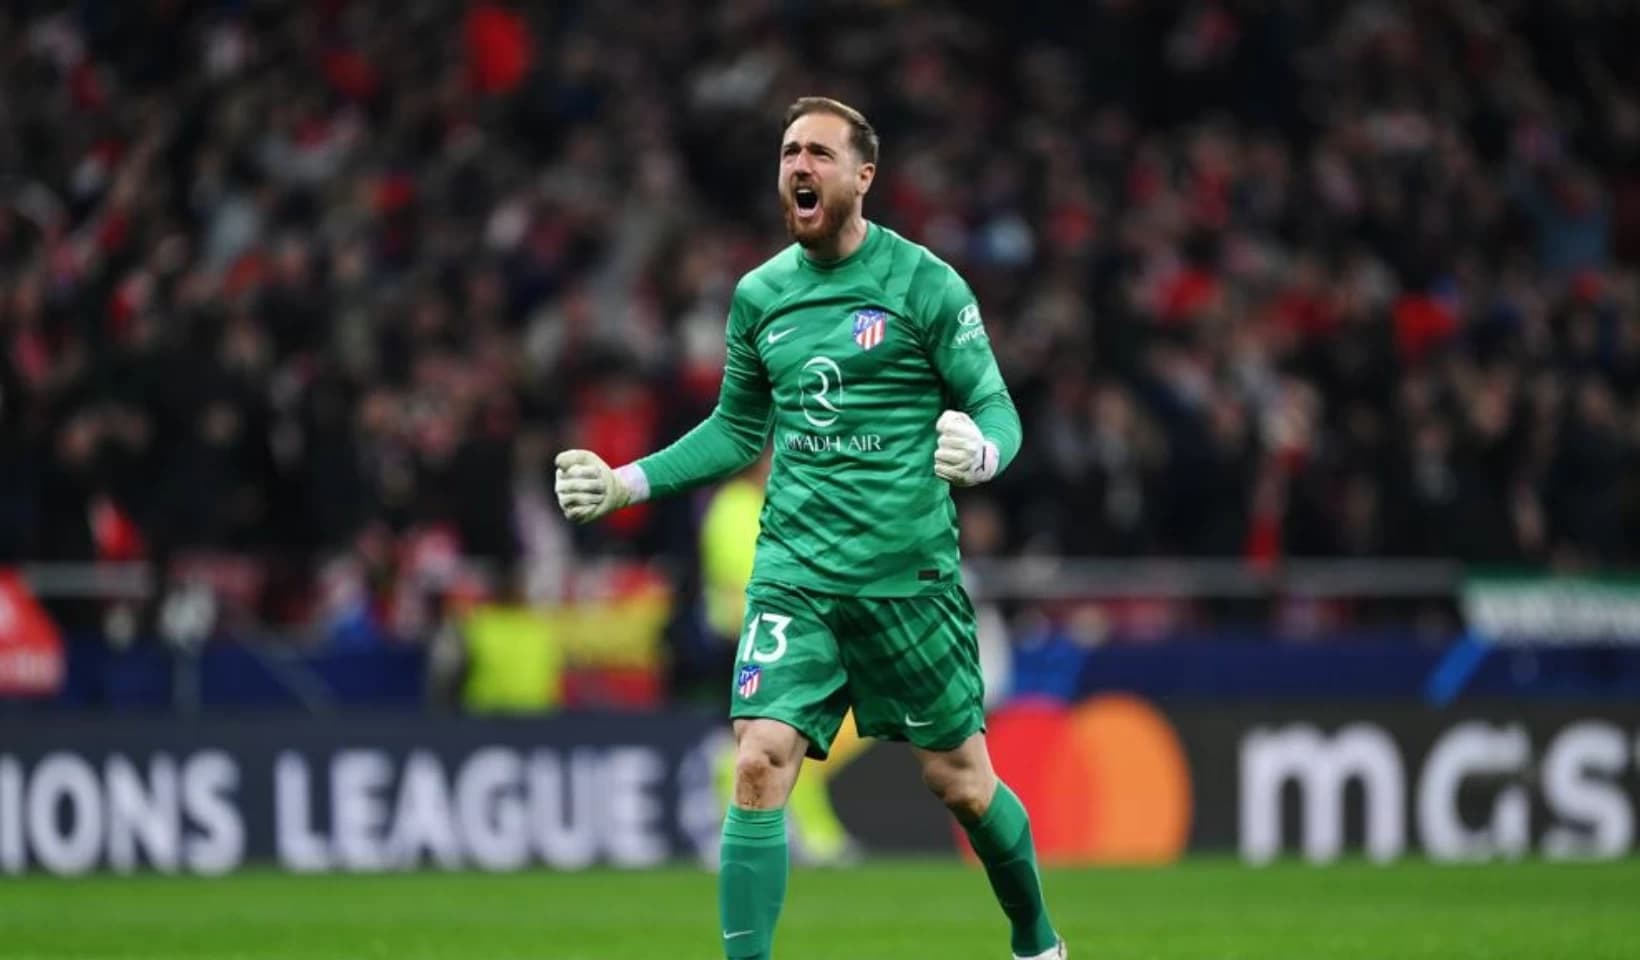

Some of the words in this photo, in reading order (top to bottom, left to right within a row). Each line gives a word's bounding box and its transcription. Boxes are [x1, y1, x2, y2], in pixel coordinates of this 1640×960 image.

[847, 434, 882, 451] AIR
[742, 612, 792, 663] 13
[0, 751, 246, 875] IONS
[273, 746, 668, 872] LEAGUE
